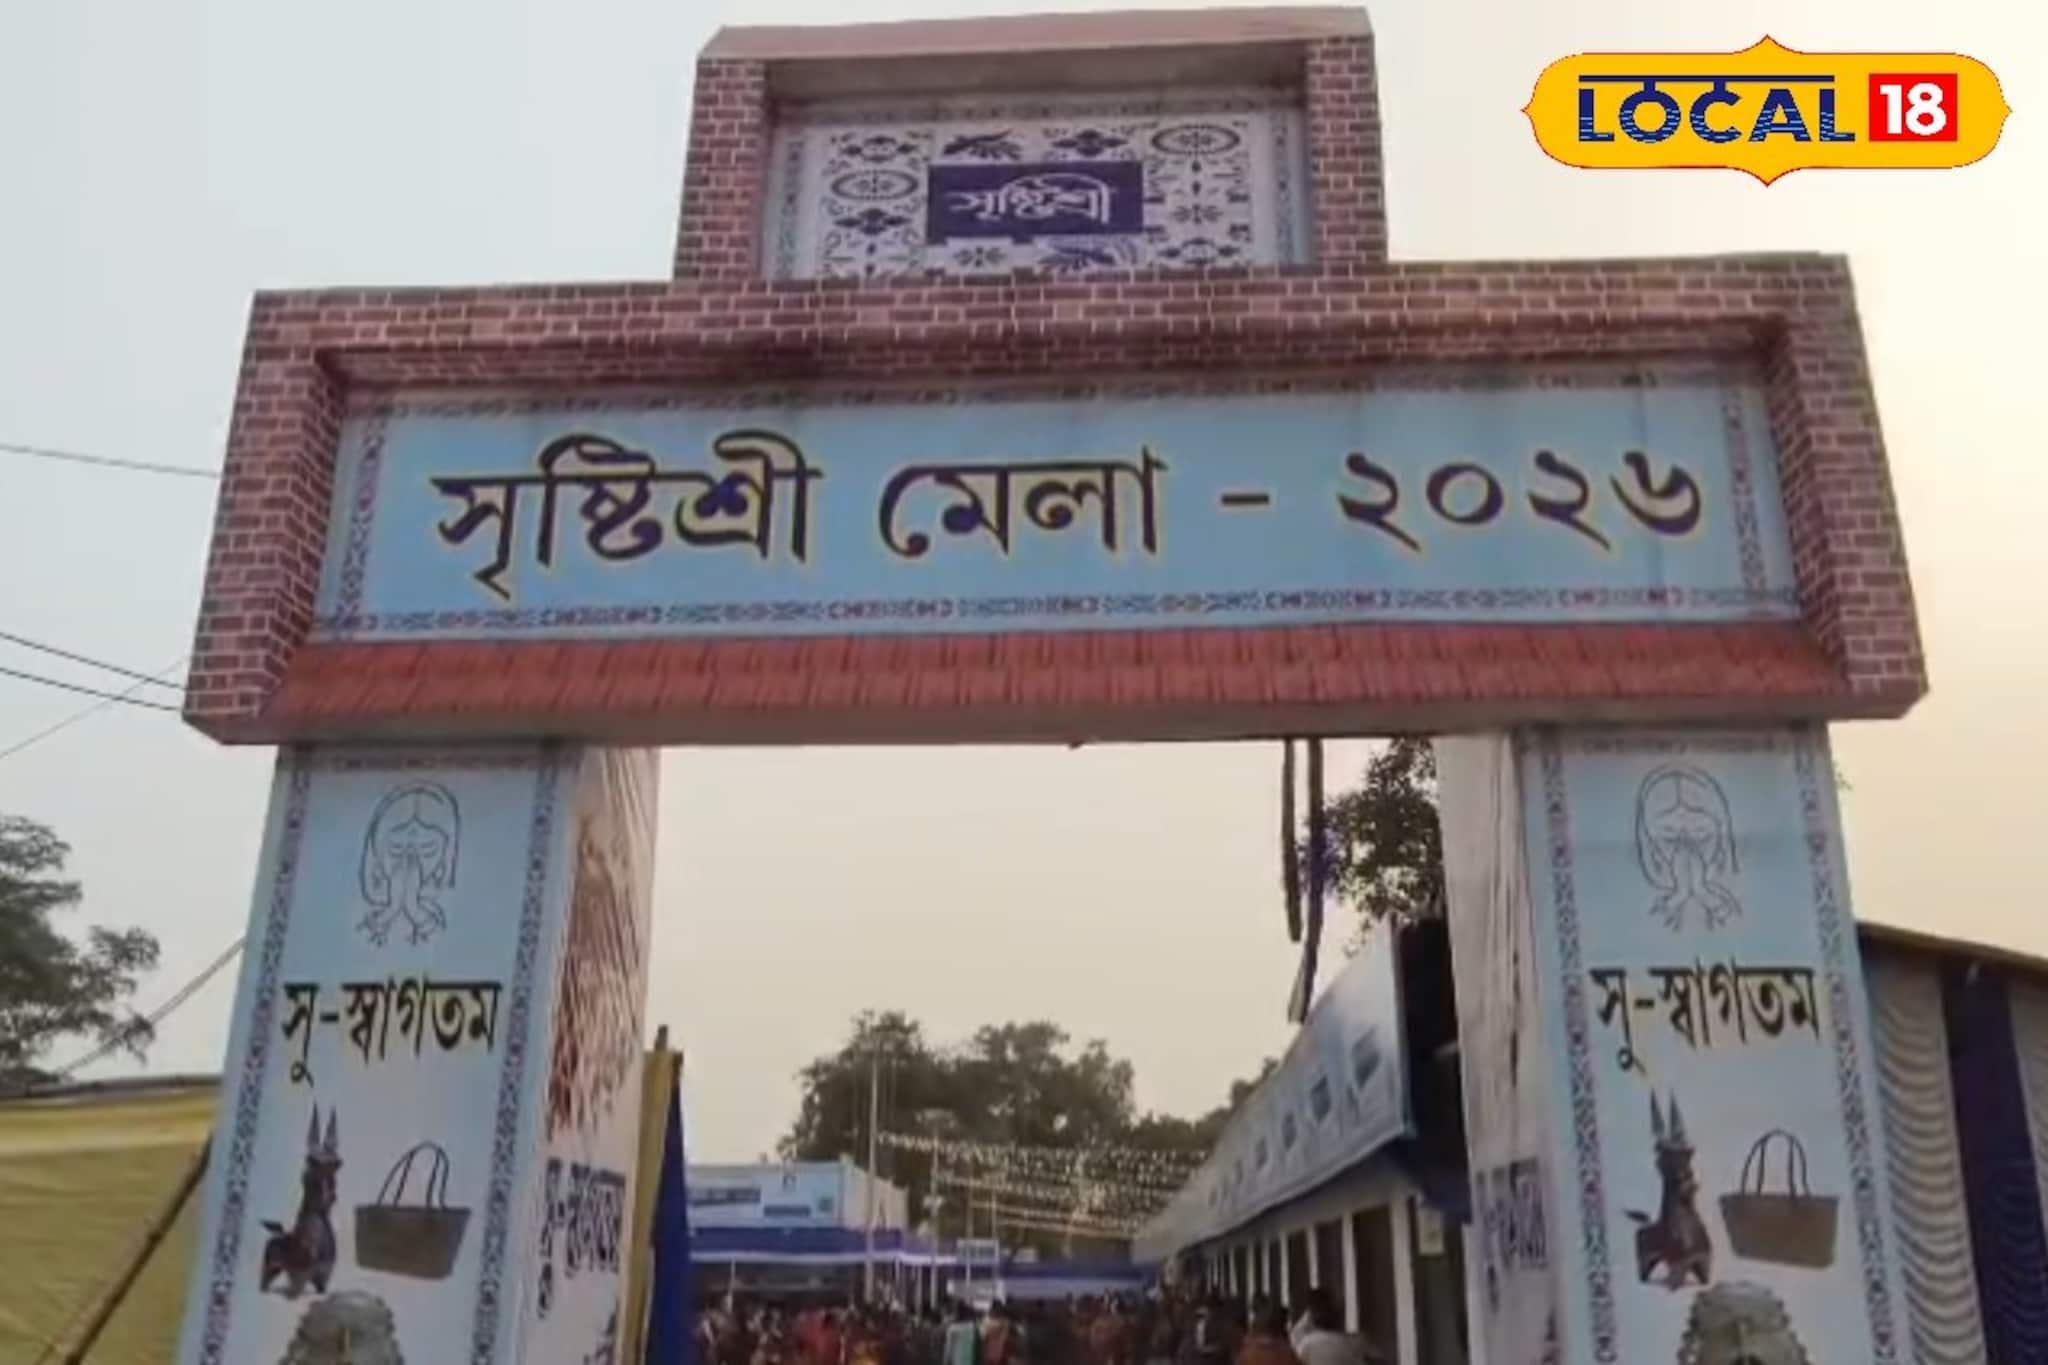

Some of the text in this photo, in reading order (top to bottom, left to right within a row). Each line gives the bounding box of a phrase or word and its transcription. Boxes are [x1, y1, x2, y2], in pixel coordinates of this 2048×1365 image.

[430, 429, 824, 599] সৃষ্টিশ্রী
[879, 445, 1167, 556] মেলা
[1337, 450, 1701, 552] ২০২৬
